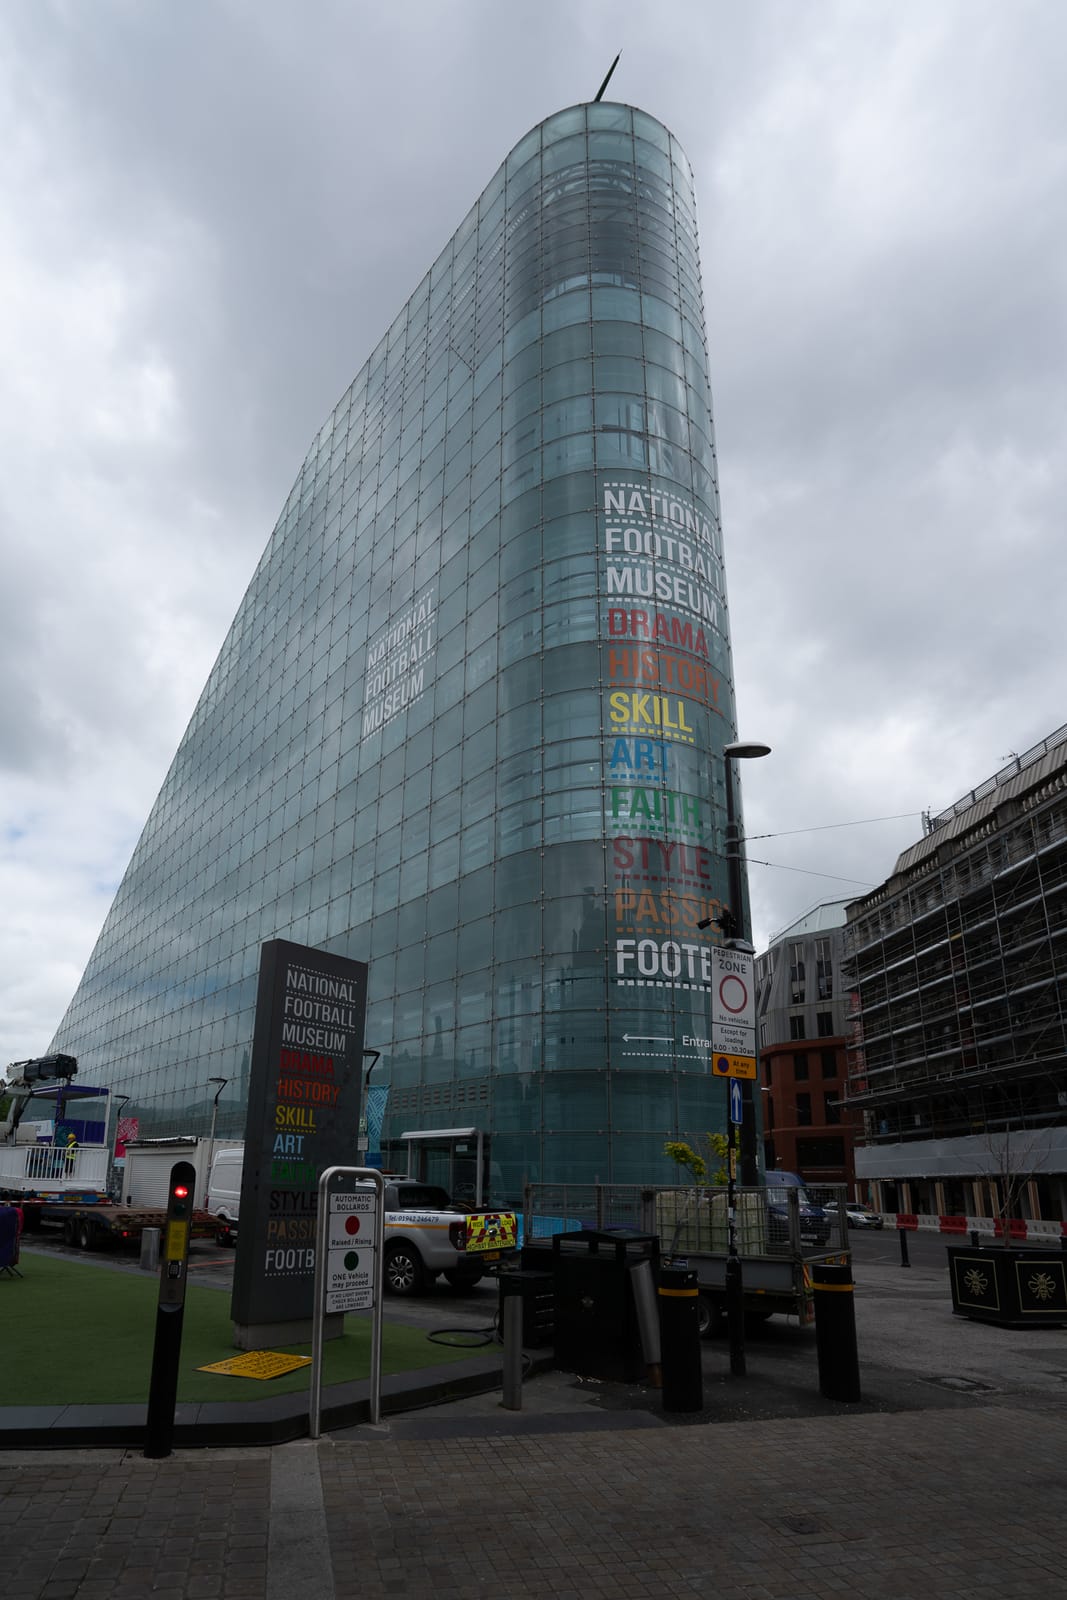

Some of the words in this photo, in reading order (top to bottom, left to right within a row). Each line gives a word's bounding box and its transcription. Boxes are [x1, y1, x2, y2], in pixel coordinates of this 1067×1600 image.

[604, 490, 720, 557] NATIONAL
[605, 528, 722, 594] FOOTBALL
[607, 567, 719, 627] MUSEUM
[368, 598, 436, 673] NATIONAL
[608, 608, 709, 660] DRAMA
[365, 629, 435, 703] FOOTBALL
[609, 649, 720, 703] HISTORY
[363, 668, 424, 738] MUSEUM
[609, 692, 693, 733] SKILL
[609, 738, 673, 772] ART
[611, 787, 702, 829] FAITH
[613, 835, 710, 880] STYLE
[616, 888, 728, 934] PASSIO
[713, 948, 752, 963] PEDESTRIAN
[719, 959, 747, 974] ZONE
[286, 969, 356, 1003] NATIONAL
[284, 996, 355, 1028] FOOTBALL
[719, 1014, 728, 1022] No
[728, 1015, 749, 1025] vehicles
[282, 1023, 345, 1052] MUSEUM
[720, 1027, 739, 1036] Except
[739, 1029, 748, 1037] for
[724, 1037, 744, 1046] loading
[280, 1049, 334, 1076] DRAMA
[278, 1079, 340, 1102] HISTORY
[275, 1105, 317, 1128] SKILL
[273, 1134, 304, 1154] ART
[271, 1161, 317, 1182] FAITH
[270, 1190, 318, 1211] STYLE
[335, 1194, 371, 1203] AUTOMATIC
[355, 1237, 372, 1246] Rising
[332, 1273, 346, 1281] ONE
[348, 1272, 369, 1280] Vehicle
[345, 1279, 369, 1288] proceed
